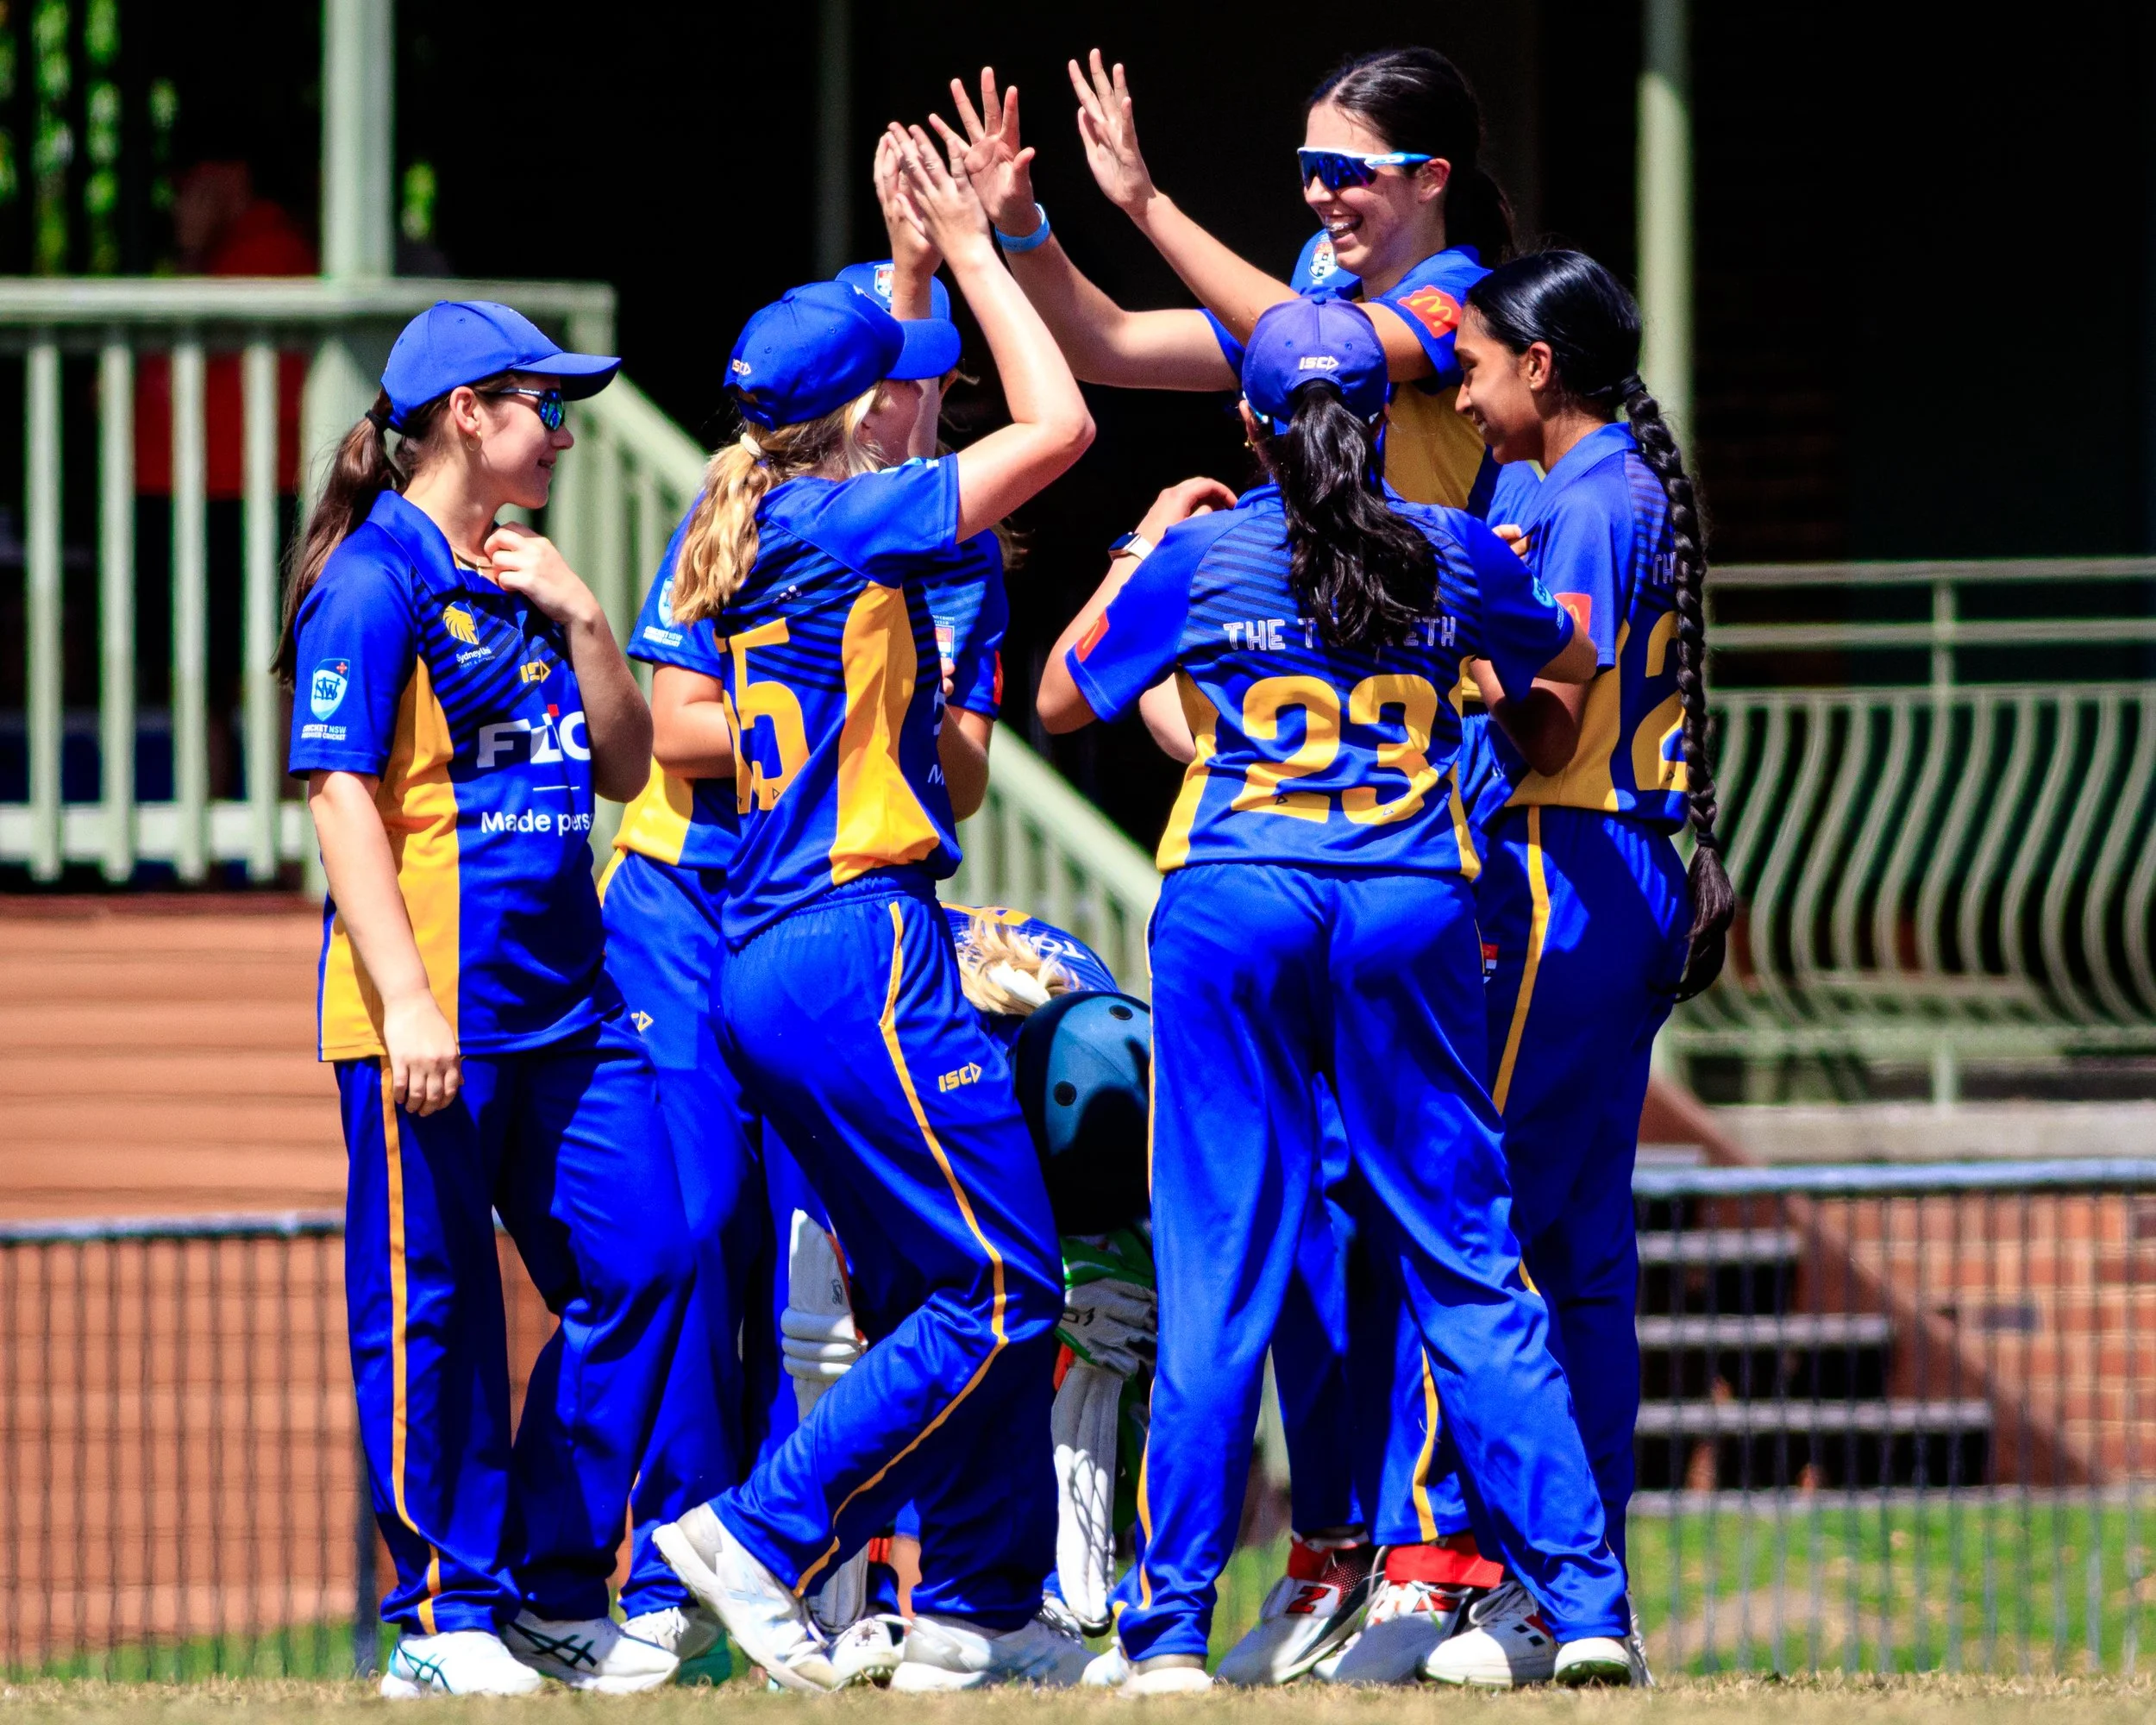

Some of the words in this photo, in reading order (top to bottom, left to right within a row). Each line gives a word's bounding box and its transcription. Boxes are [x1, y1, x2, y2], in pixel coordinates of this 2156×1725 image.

[1223, 619, 1286, 650] THE
[456, 649, 482, 663] Sydney
[329, 725, 347, 735] NSW
[1231, 674, 1438, 825] 23
[481, 808, 552, 833] Made
[557, 812, 594, 837] pers
[938, 1065, 972, 1093] ISC
